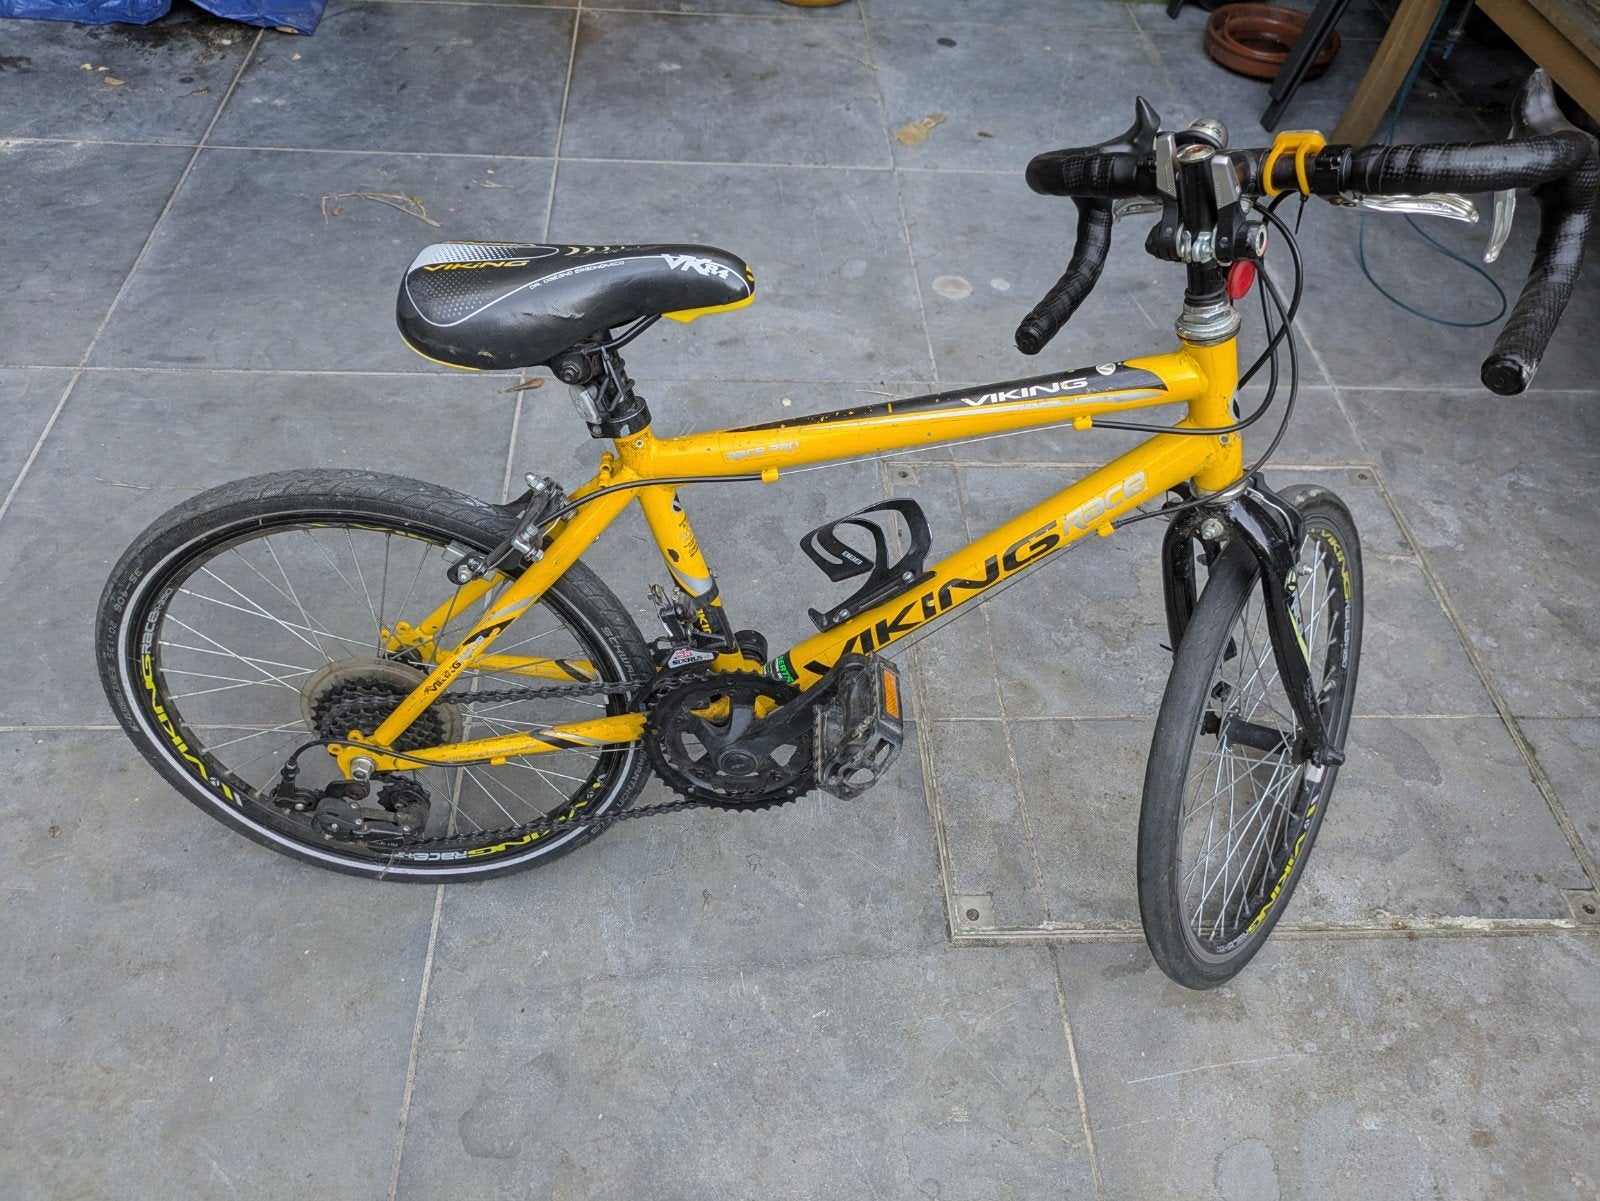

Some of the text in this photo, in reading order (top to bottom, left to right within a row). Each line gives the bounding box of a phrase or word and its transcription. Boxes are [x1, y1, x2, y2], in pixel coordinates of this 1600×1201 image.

[423, 259, 530, 272] VIKING
[961, 377, 1088, 406] VIKING
[803, 520, 1060, 675] VIKING
[601, 626, 636, 681] SCHWAL
[141, 654, 208, 780] VIKING
[1248, 831, 1307, 935] VIKING
